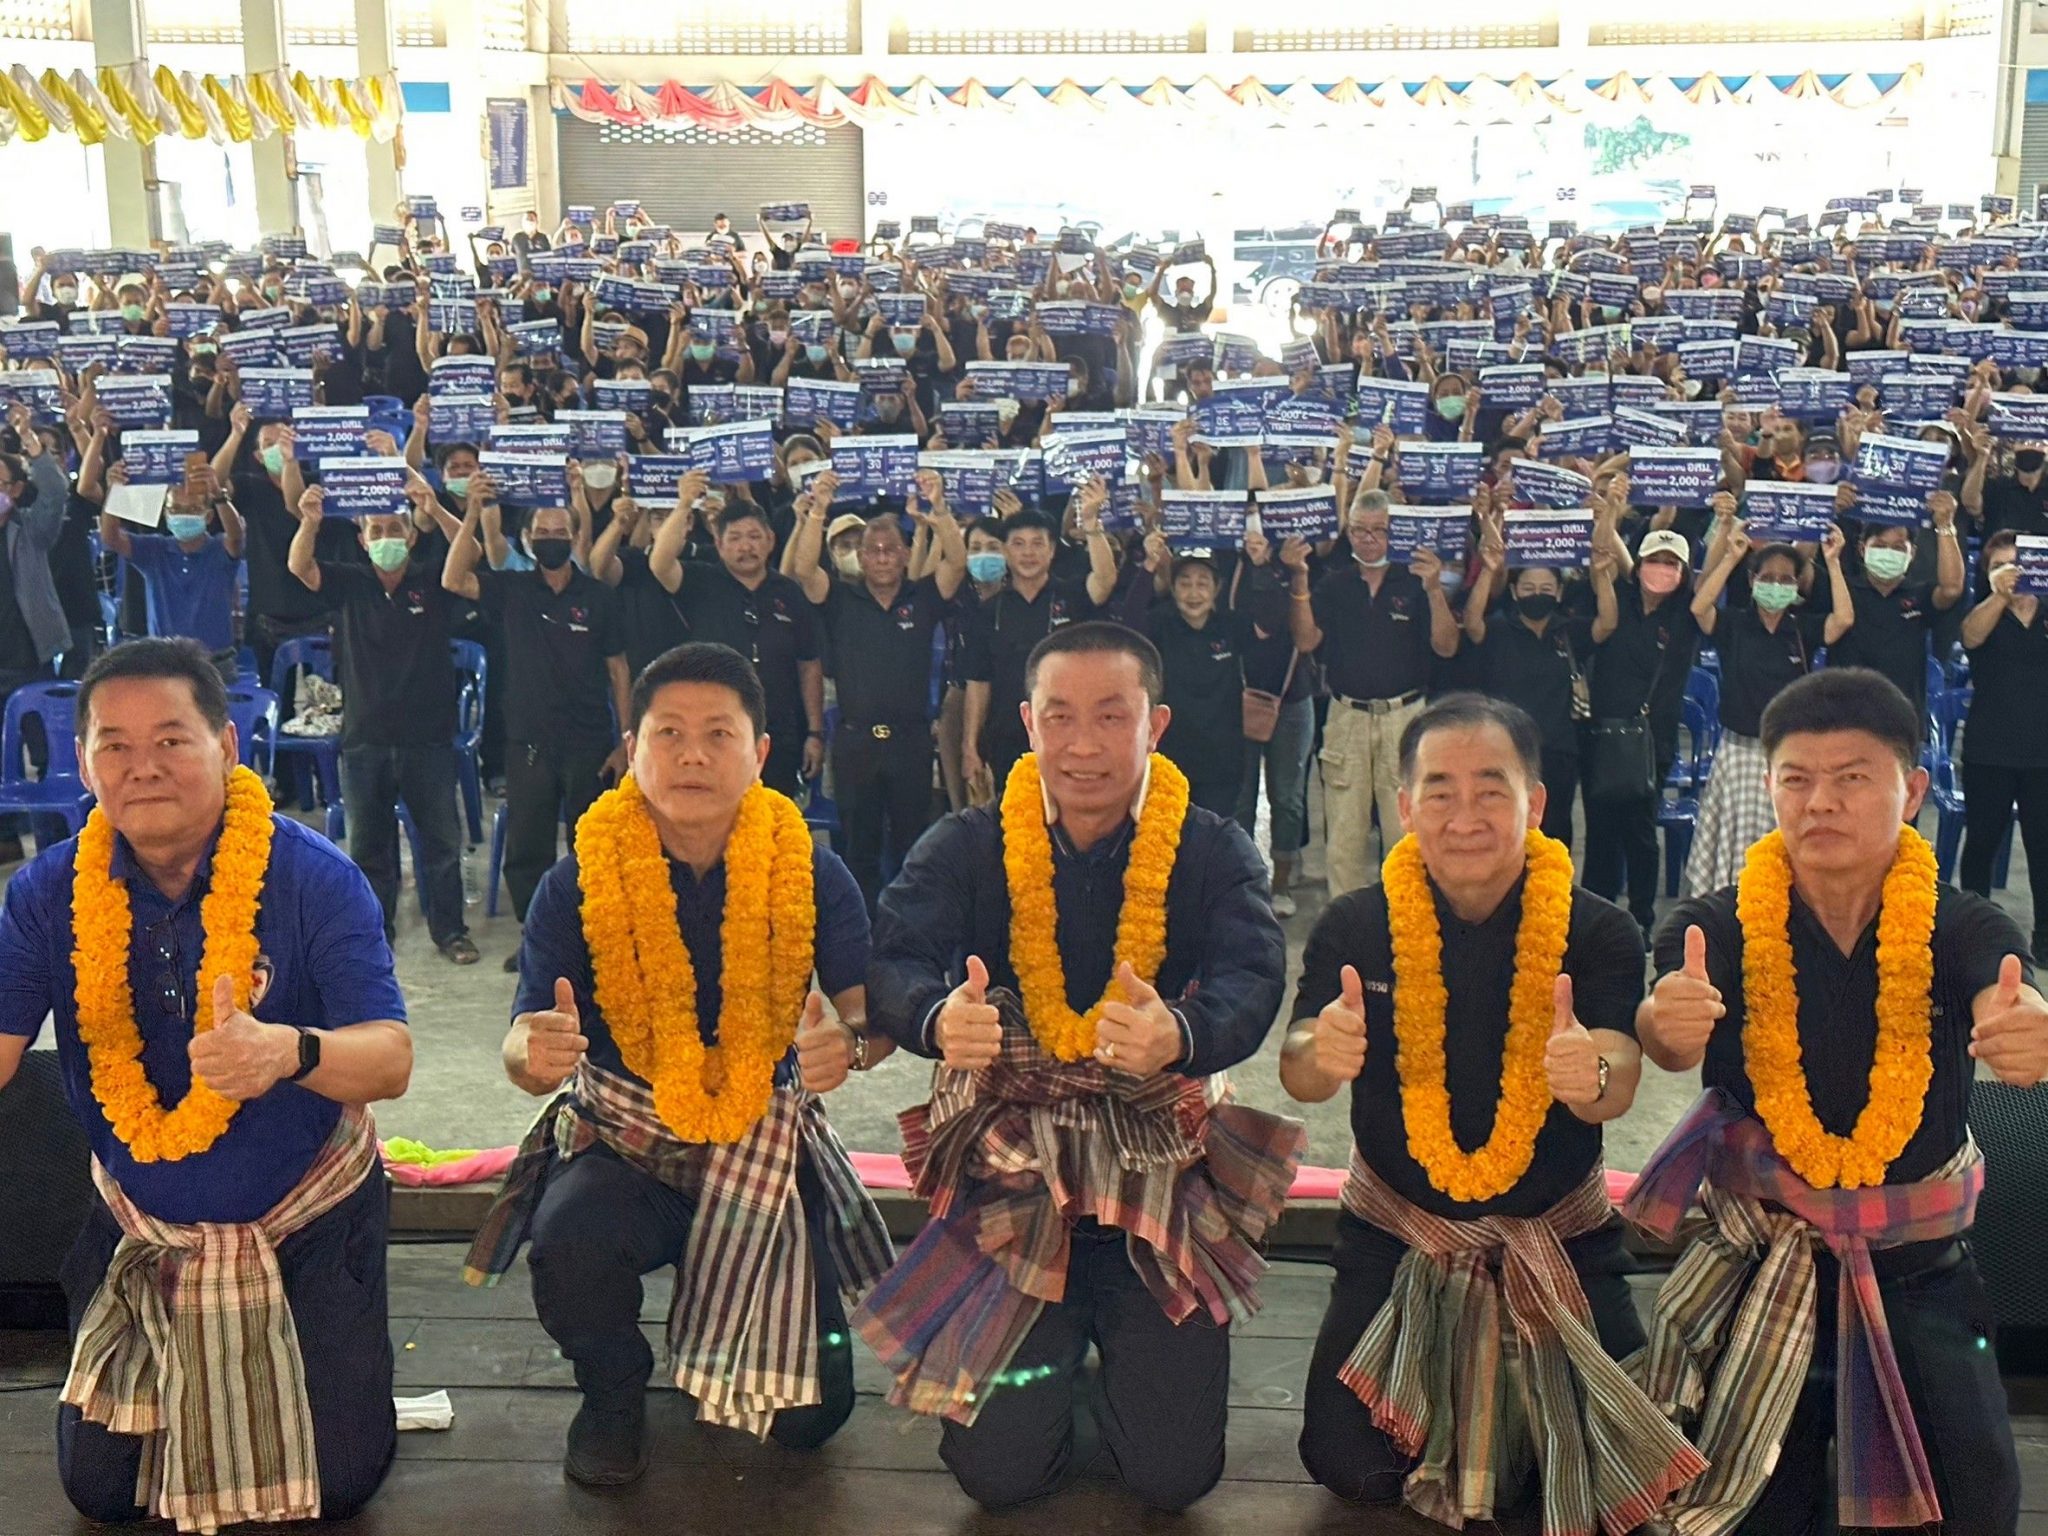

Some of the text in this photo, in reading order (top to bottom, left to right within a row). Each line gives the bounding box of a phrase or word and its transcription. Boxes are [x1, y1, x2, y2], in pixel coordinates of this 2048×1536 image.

[327, 432, 353, 443] 2,000
[1668, 475, 1700, 487] 2,000
[359, 485, 391, 497] 2,000
[1291, 514, 1321, 527] 2,000
[1545, 537, 1575, 549] 2,000
